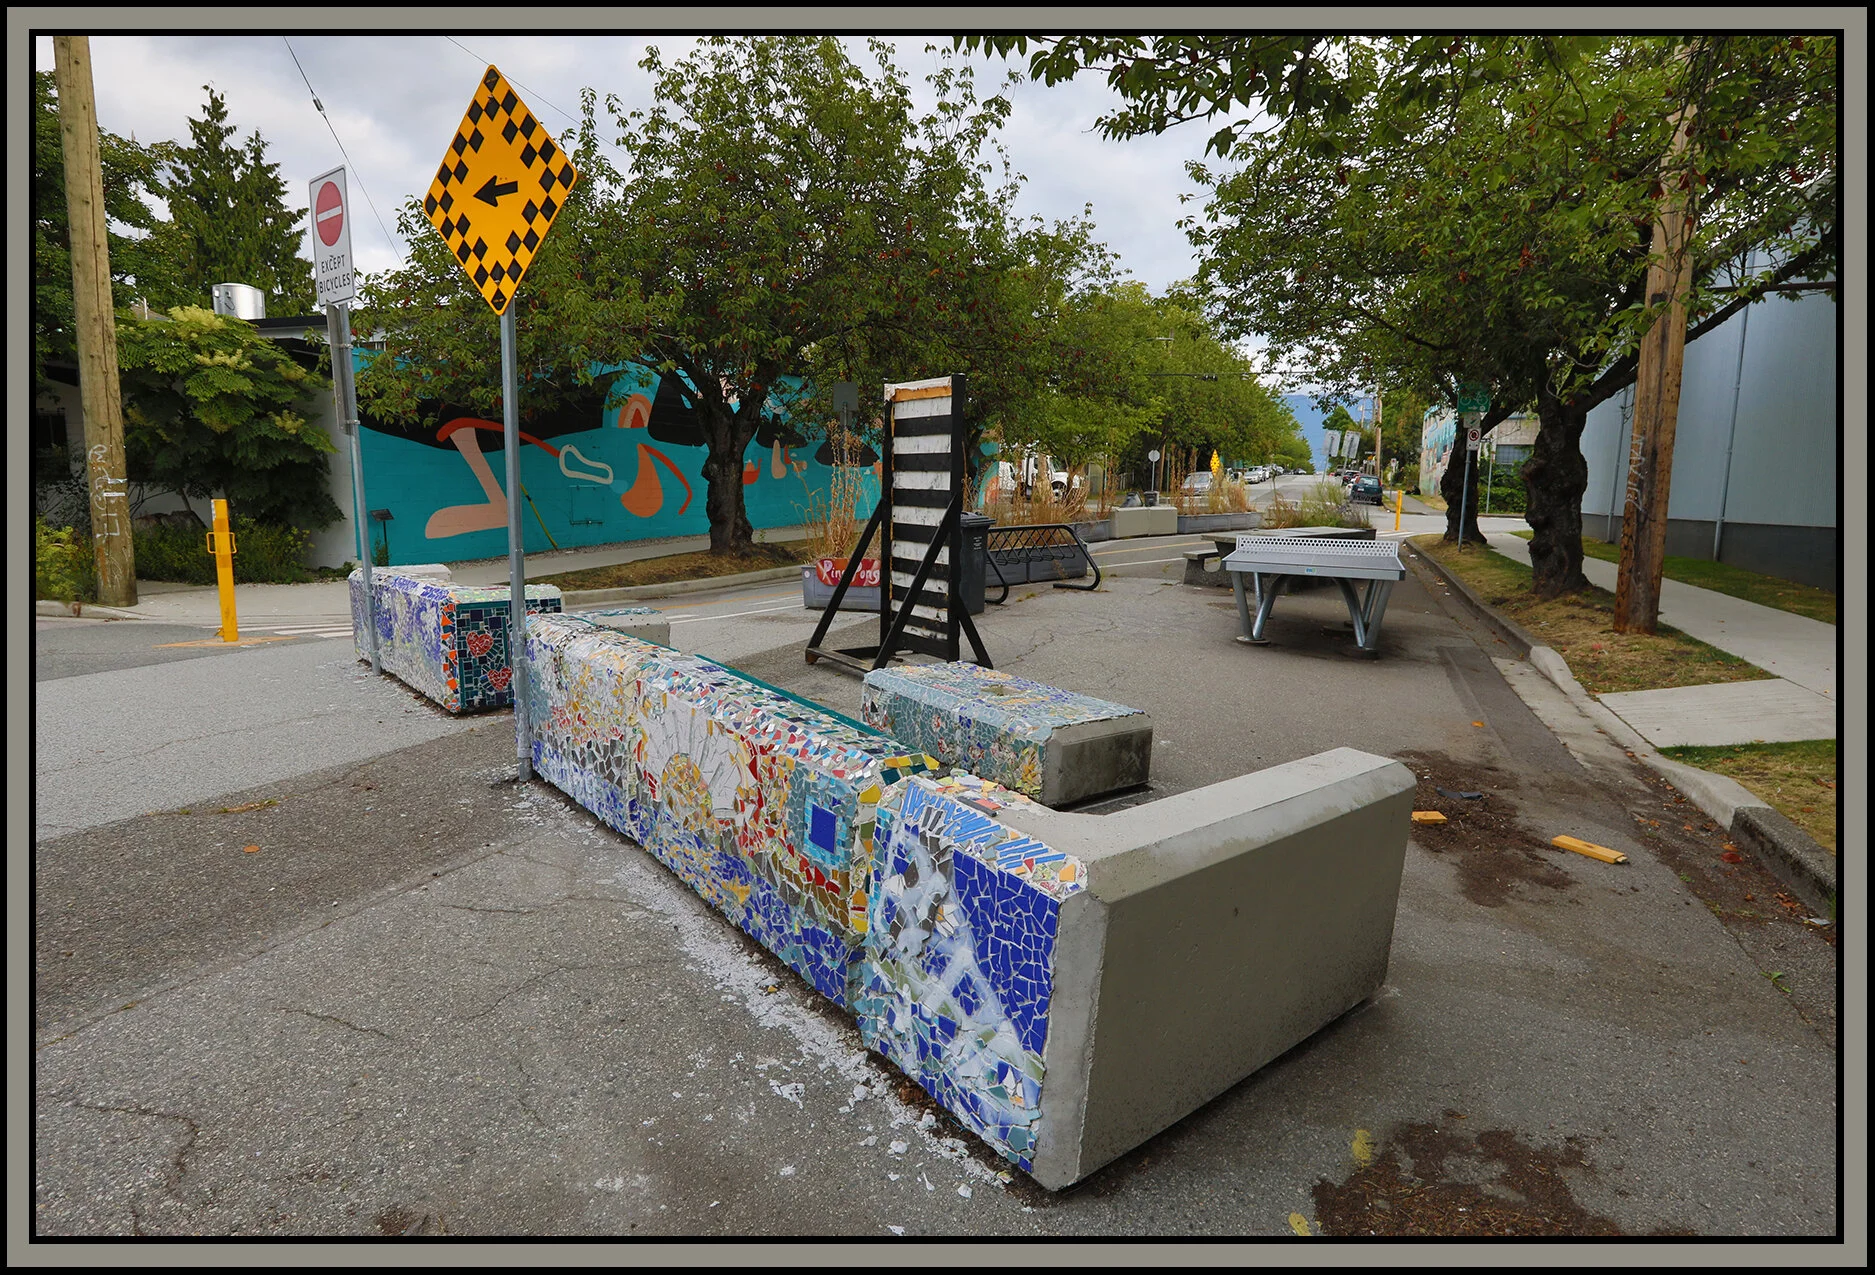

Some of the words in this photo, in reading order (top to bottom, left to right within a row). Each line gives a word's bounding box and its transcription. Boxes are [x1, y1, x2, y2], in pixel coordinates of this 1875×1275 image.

[321, 255, 345, 274] EXCEPT
[319, 273, 351, 293] BICYCLES
[821, 560, 846, 580] Pin
